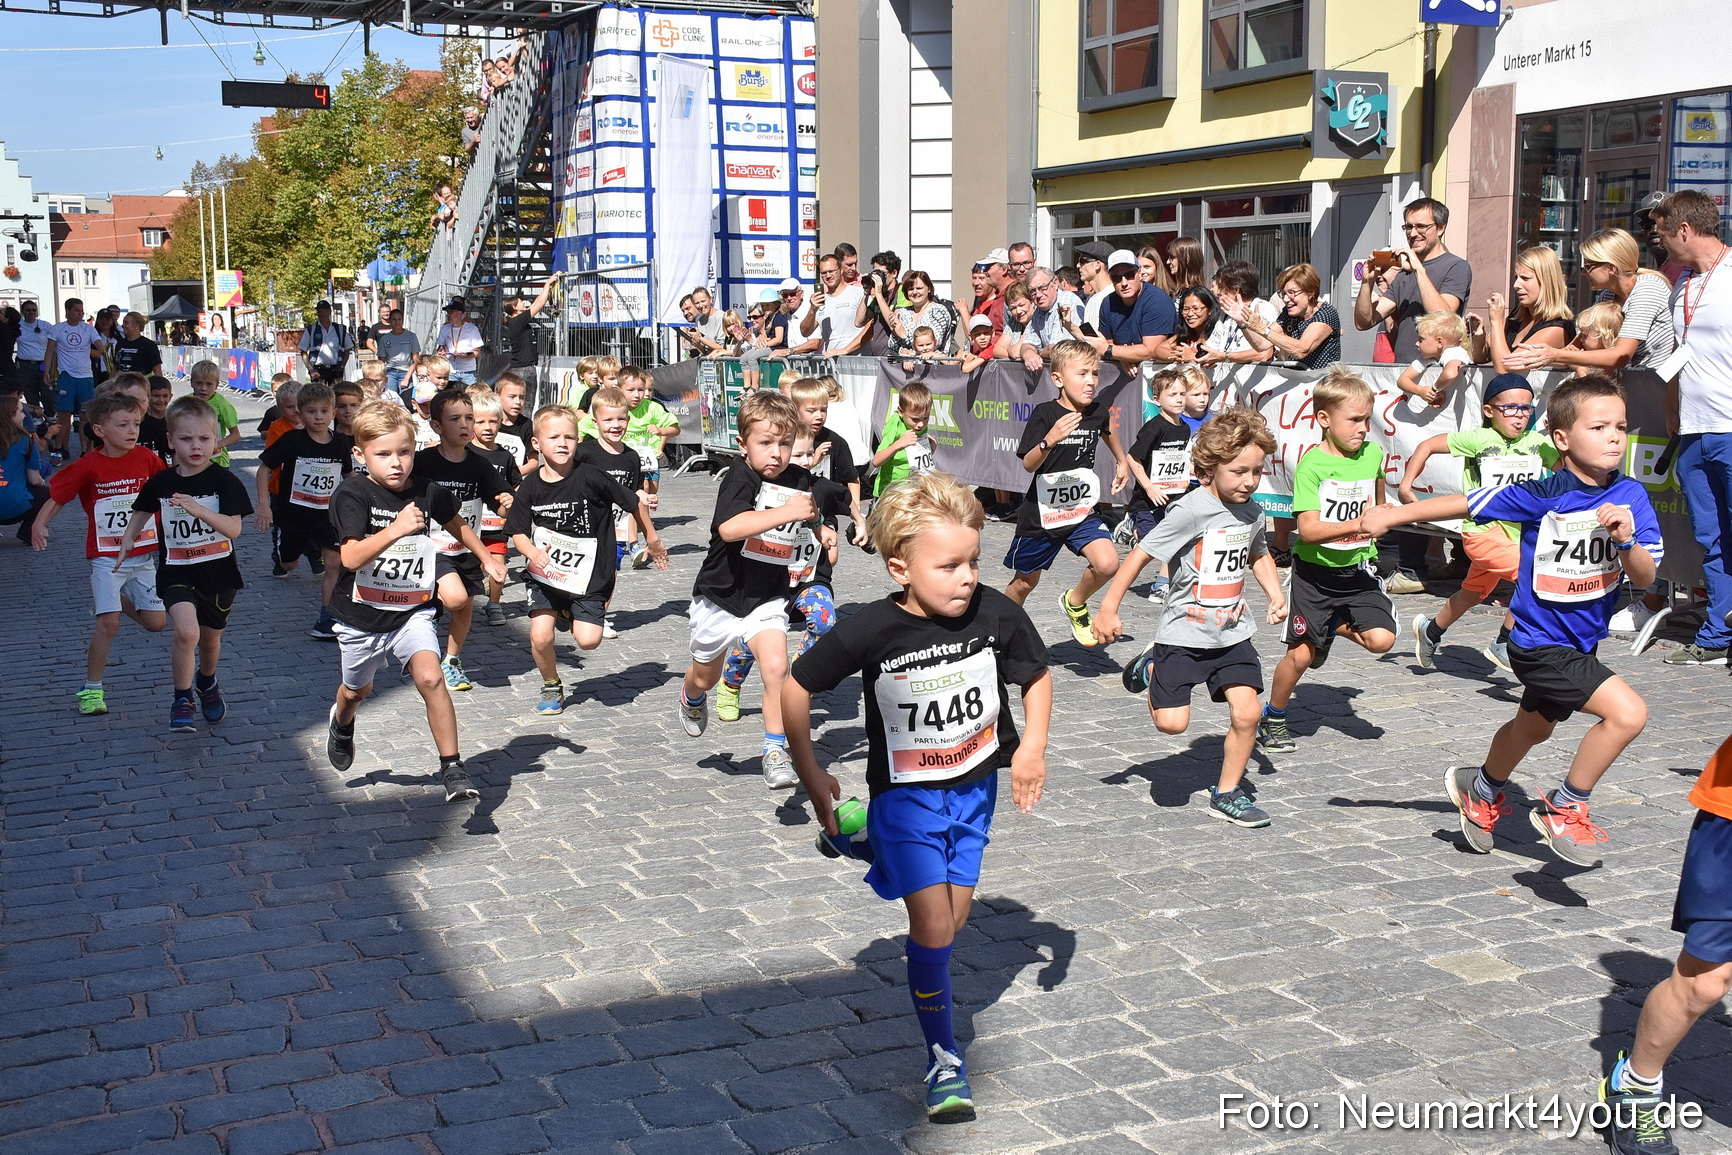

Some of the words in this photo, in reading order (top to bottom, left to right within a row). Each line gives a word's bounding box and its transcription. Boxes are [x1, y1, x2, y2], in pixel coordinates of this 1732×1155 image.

[682, 27, 701, 35] CODE
[1503, 52, 1542, 71] Unterer
[1544, 43, 1576, 64] Markt
[1579, 40, 1592, 58] 15
[801, 76, 816, 90] He
[314, 88, 327, 106] 4
[1348, 94, 1372, 129] G2
[798, 125, 816, 134] SW
[1556, 152, 1582, 164] Jugen
[603, 210, 643, 218] VARIOTEC
[749, 216, 767, 226] Braun
[740, 267, 780, 276] Lammsbräu
[973, 400, 1010, 421] OFFICE
[1012, 402, 1034, 423] IND
[1158, 461, 1186, 476] 7454
[1501, 460, 1529, 469] BOCK
[95, 478, 136, 488] Neumarkter
[301, 473, 335, 490] 7435
[97, 486, 130, 495] Stadtlauf
[1047, 483, 1092, 504] 7502
[1336, 486, 1363, 496] BOCK
[104, 510, 134, 529] 73
[1566, 519, 1600, 533] BOC
[185, 548, 206, 558] Elias
[543, 541, 586, 568] 427
[794, 543, 815, 562] 19
[1213, 546, 1249, 573] 756
[371, 556, 425, 581] 7374
[1556, 567, 1578, 575] PARTL
[1579, 567, 1607, 575] Neumarkt
[373, 580, 391, 588] PARTL
[546, 570, 568, 584] Oliver
[1567, 579, 1600, 593] Anton
[382, 592, 409, 603] Louis
[1186, 606, 1207, 625] BE
[880, 641, 964, 673] Neumarkter
[909, 671, 965, 693] BOCK
[897, 686, 984, 732] 7448
[890, 725, 899, 733] B2
[914, 737, 939, 745] PARTL
[940, 728, 974, 744] Neumarkt
[918, 738, 979, 768] Johannes
